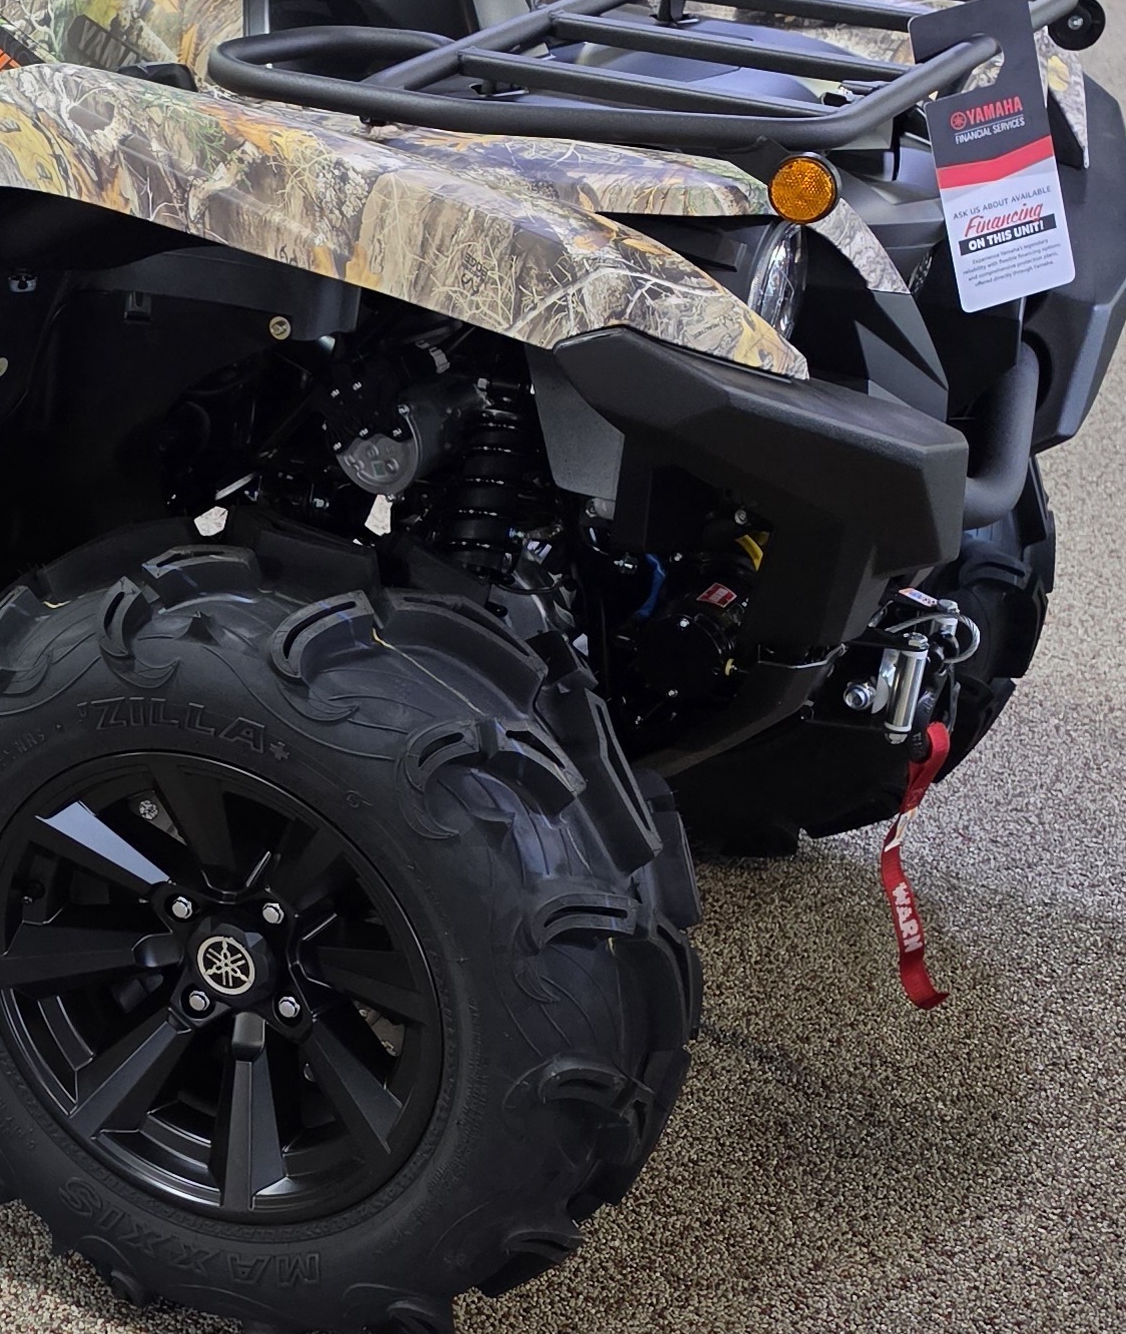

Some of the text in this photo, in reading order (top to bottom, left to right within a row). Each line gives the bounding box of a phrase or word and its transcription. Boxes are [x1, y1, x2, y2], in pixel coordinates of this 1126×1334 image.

[966, 96, 1023, 125] YAMAHA
[955, 117, 1025, 144] FINANCIAL SERVICES
[953, 185, 1052, 220] ASK US ABOUT AVAILABLE
[964, 202, 1044, 237] Financing
[968, 220, 1044, 251] ON THIS UNIT!
[892, 881, 924, 954] WARN
[57, 1176, 321, 1287] MAXXIS
